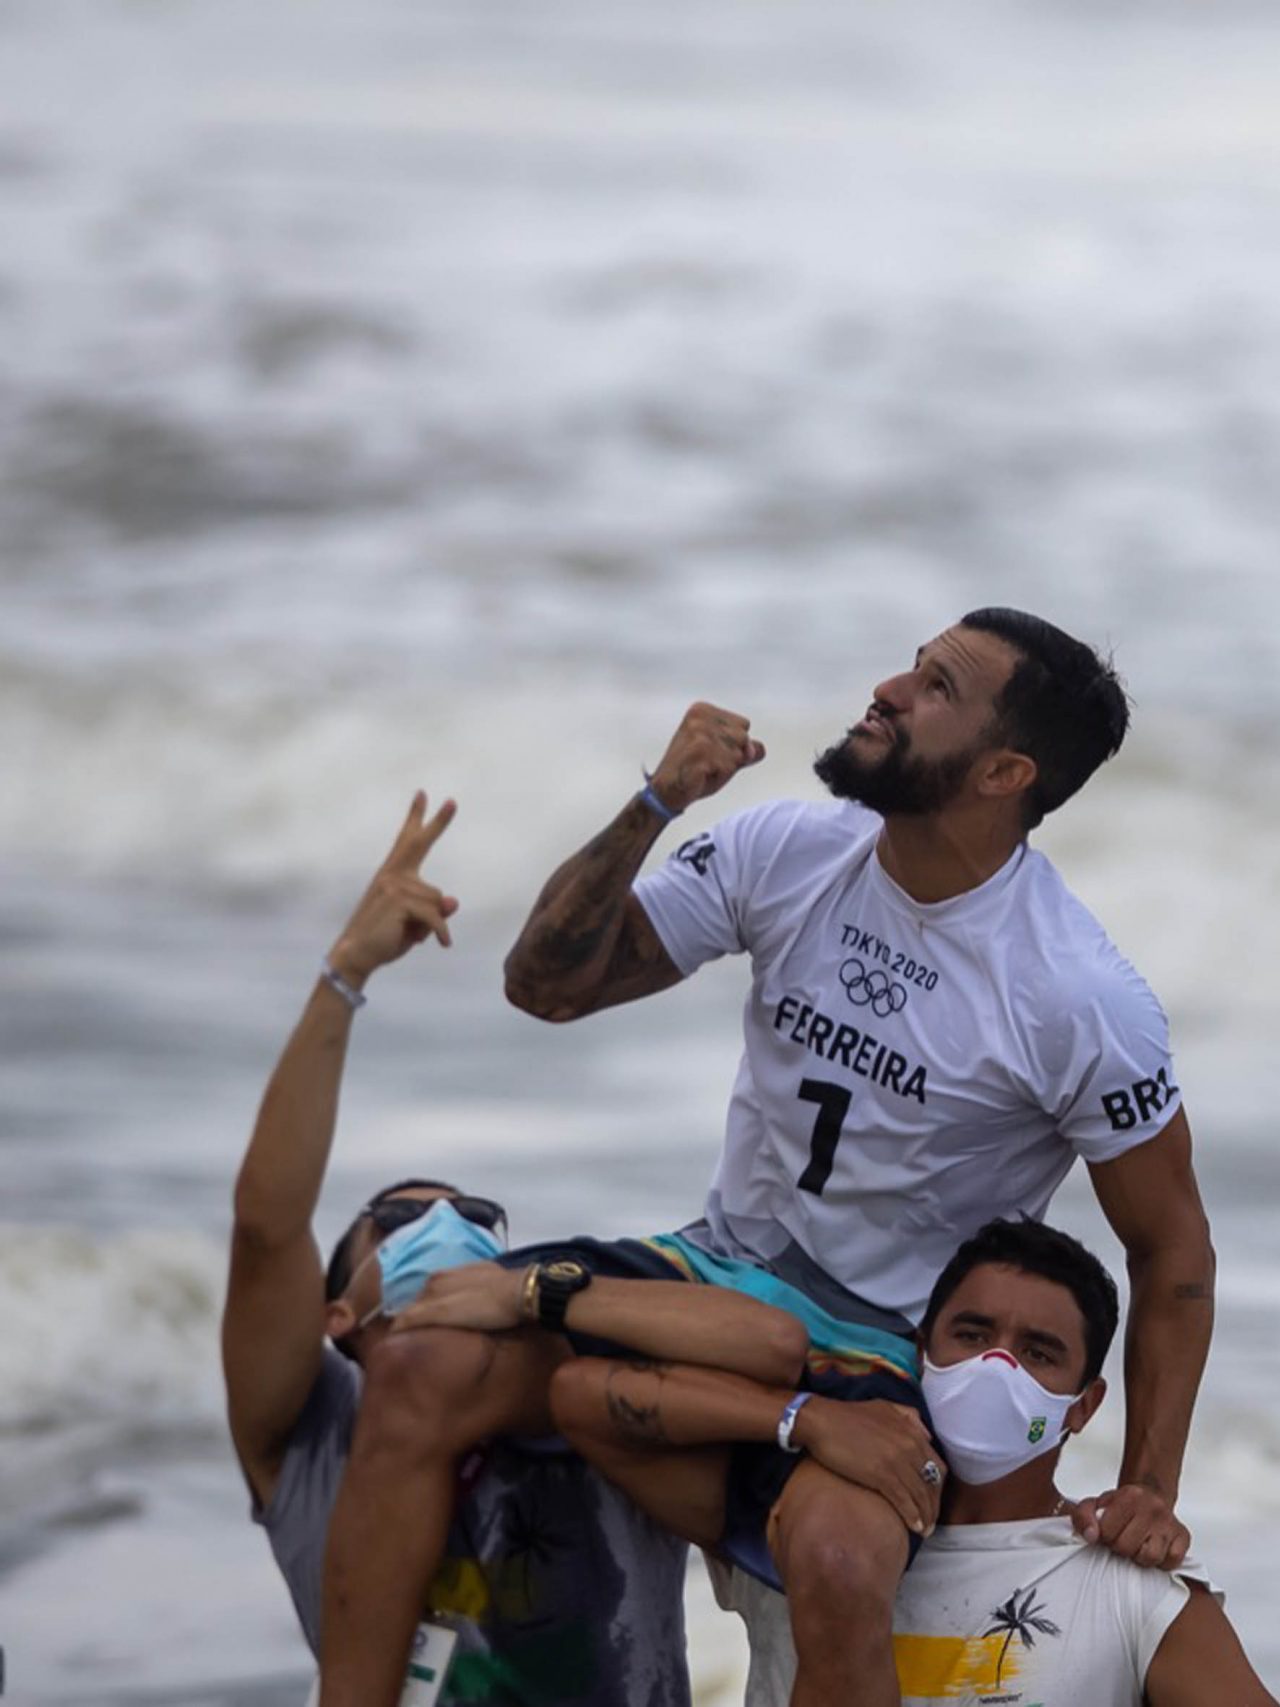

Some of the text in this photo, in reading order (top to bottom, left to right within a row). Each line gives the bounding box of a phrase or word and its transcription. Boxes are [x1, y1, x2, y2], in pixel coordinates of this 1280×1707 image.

[840, 924, 939, 992] TOKYO 2020
[774, 996, 927, 1105] FERREIRA
[797, 1077, 853, 1197] 7
